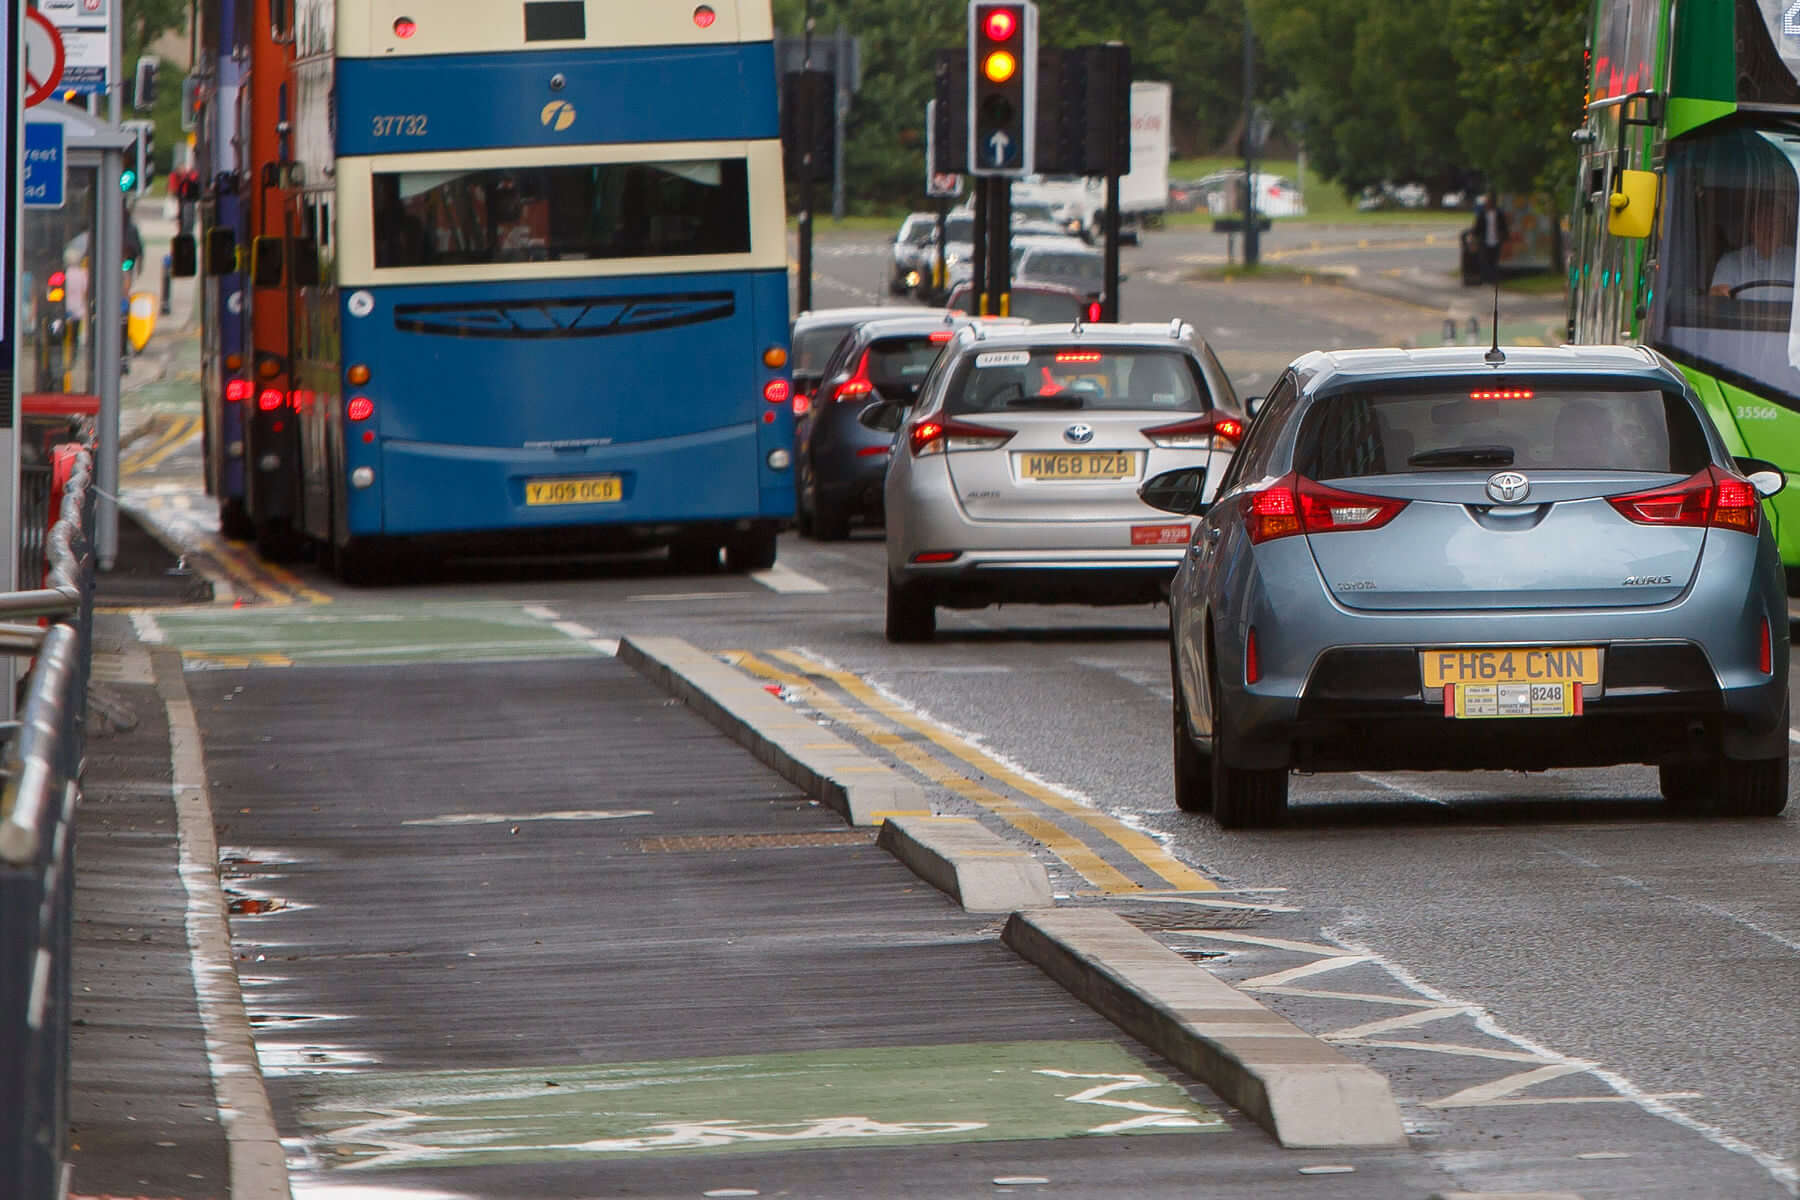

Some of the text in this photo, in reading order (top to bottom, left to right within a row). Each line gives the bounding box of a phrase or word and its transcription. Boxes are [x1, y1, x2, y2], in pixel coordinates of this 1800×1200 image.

[372, 115, 428, 136] 37732
[1736, 406, 1777, 420] 35566
[1030, 455, 1129, 475] MW68 DZB
[1622, 575, 1672, 586] AURIS
[1438, 651, 1584, 680] FH64 CNN
[1532, 687, 1562, 701] 8248
